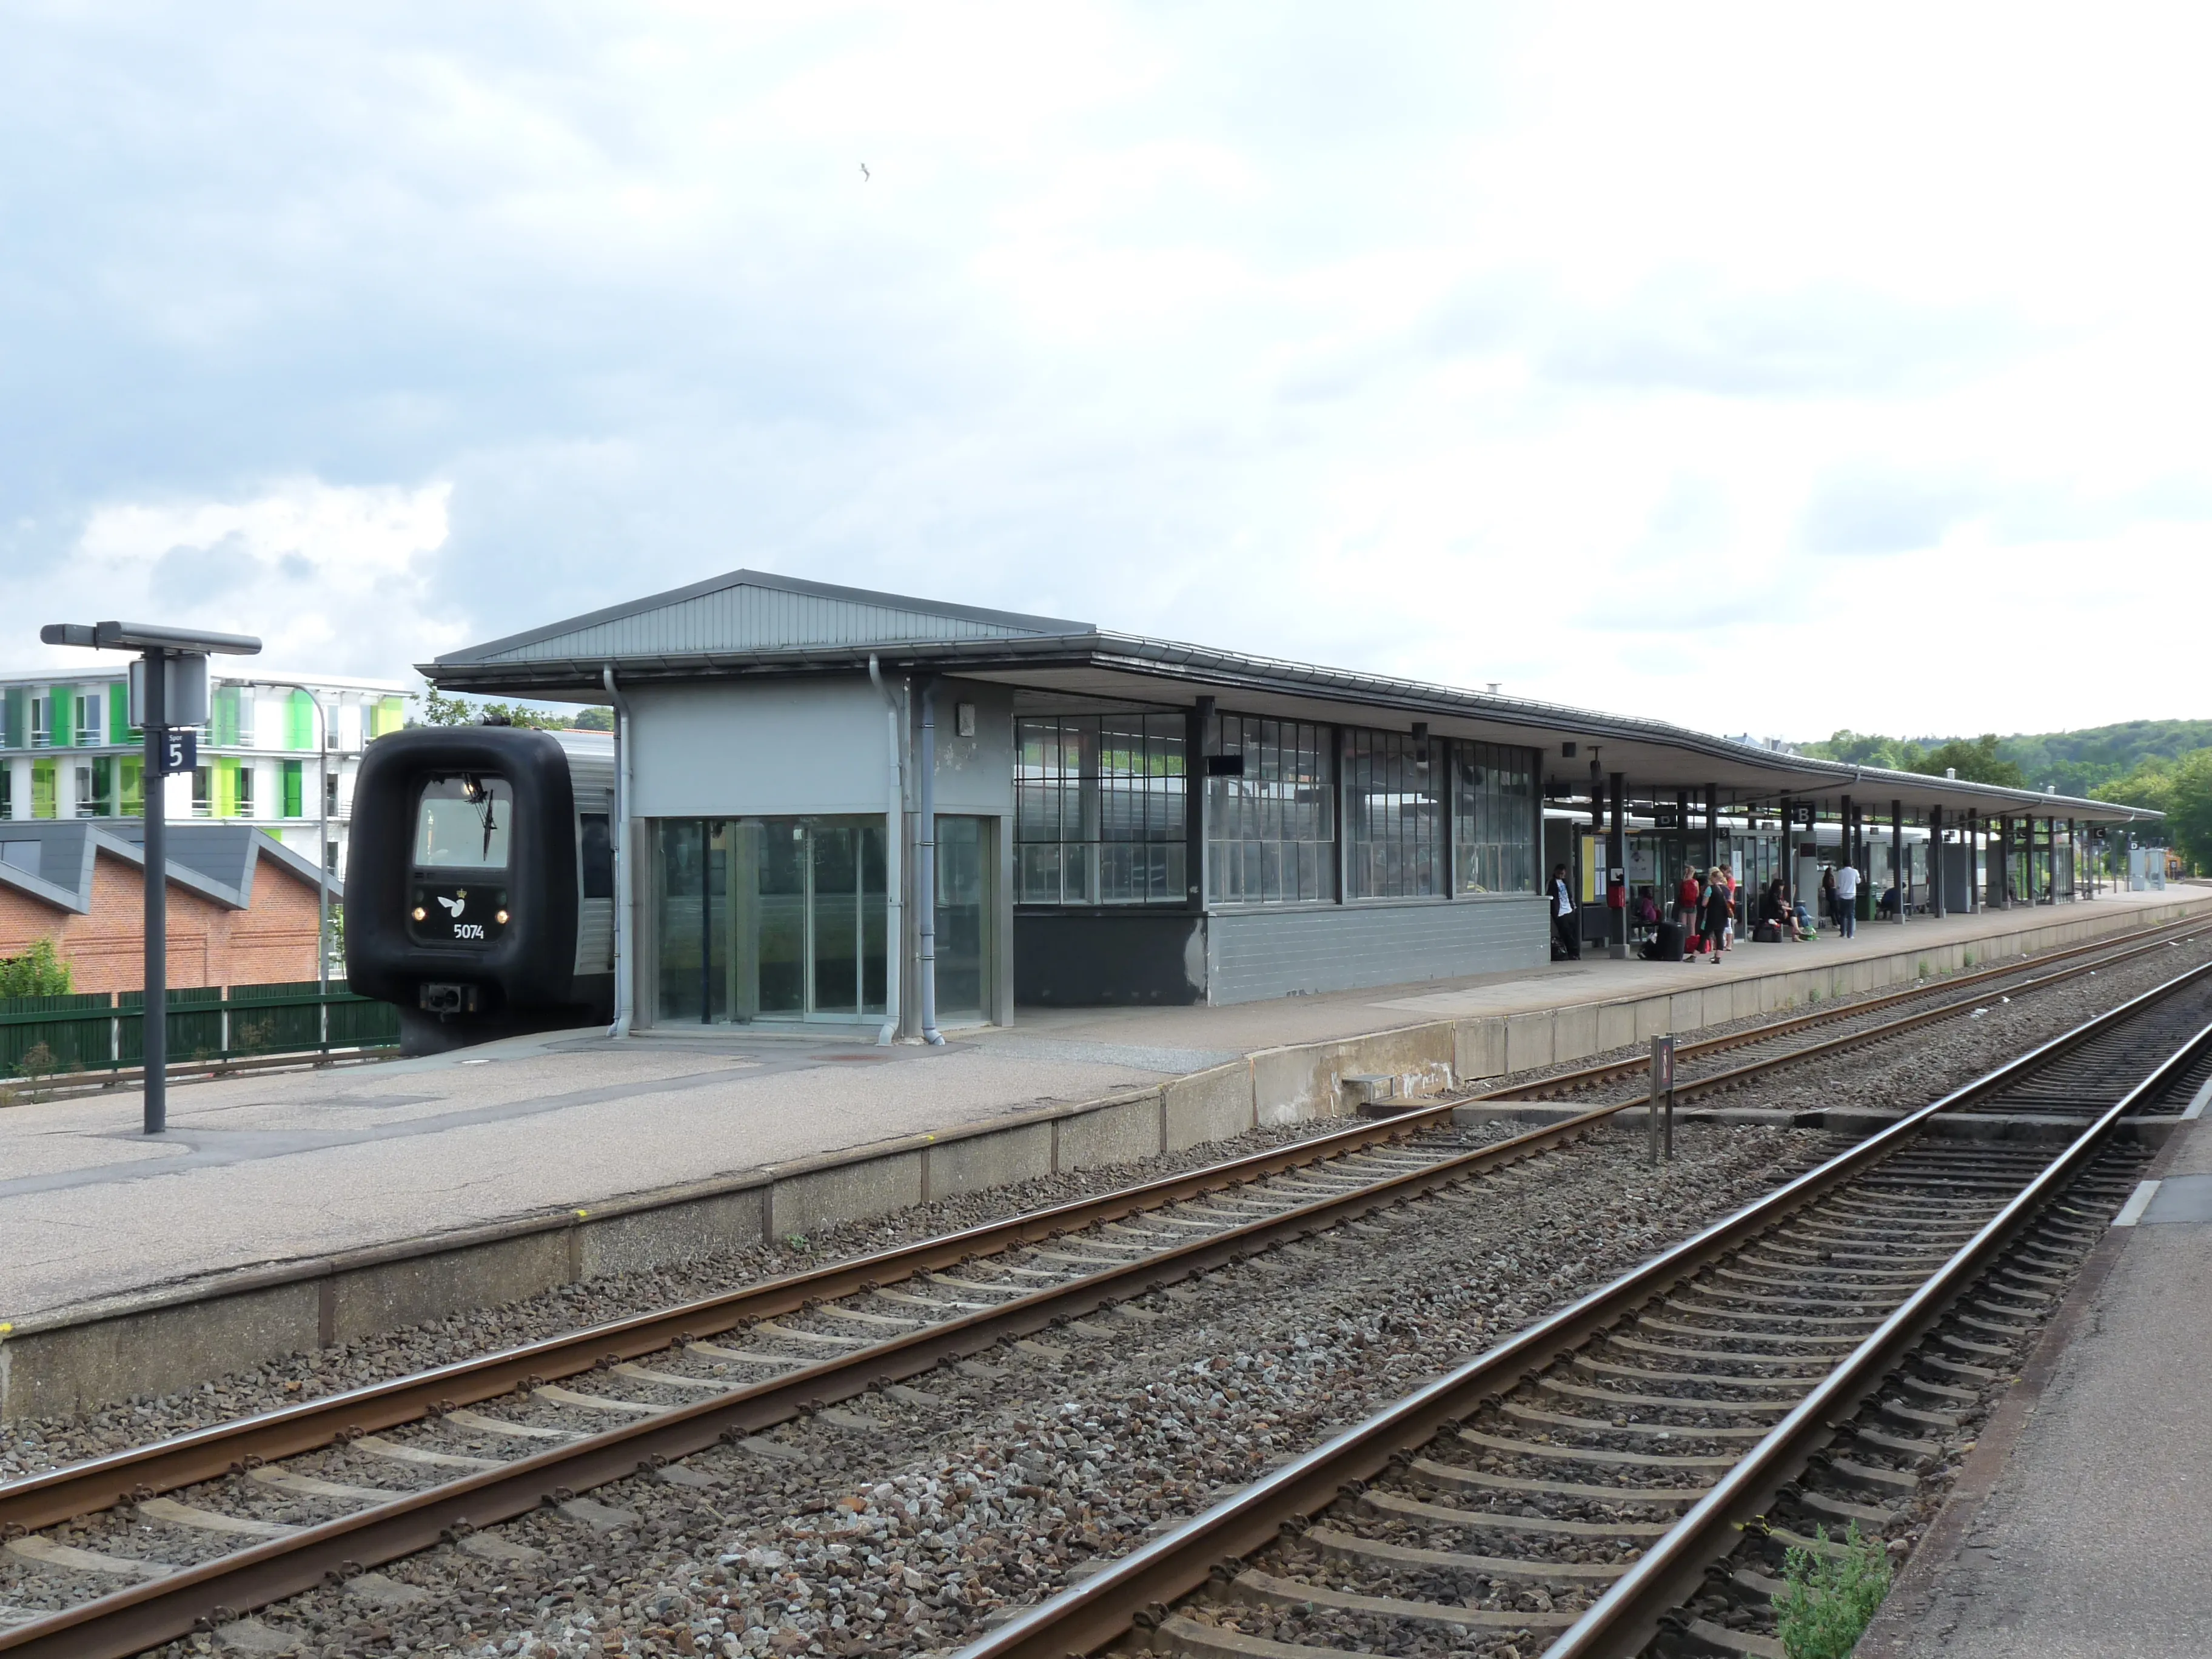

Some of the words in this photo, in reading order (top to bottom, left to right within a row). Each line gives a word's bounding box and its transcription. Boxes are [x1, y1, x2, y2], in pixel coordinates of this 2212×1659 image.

[170, 743, 183, 766] 5
[1798, 808, 1810, 821] B
[454, 924, 484, 939] 5074
